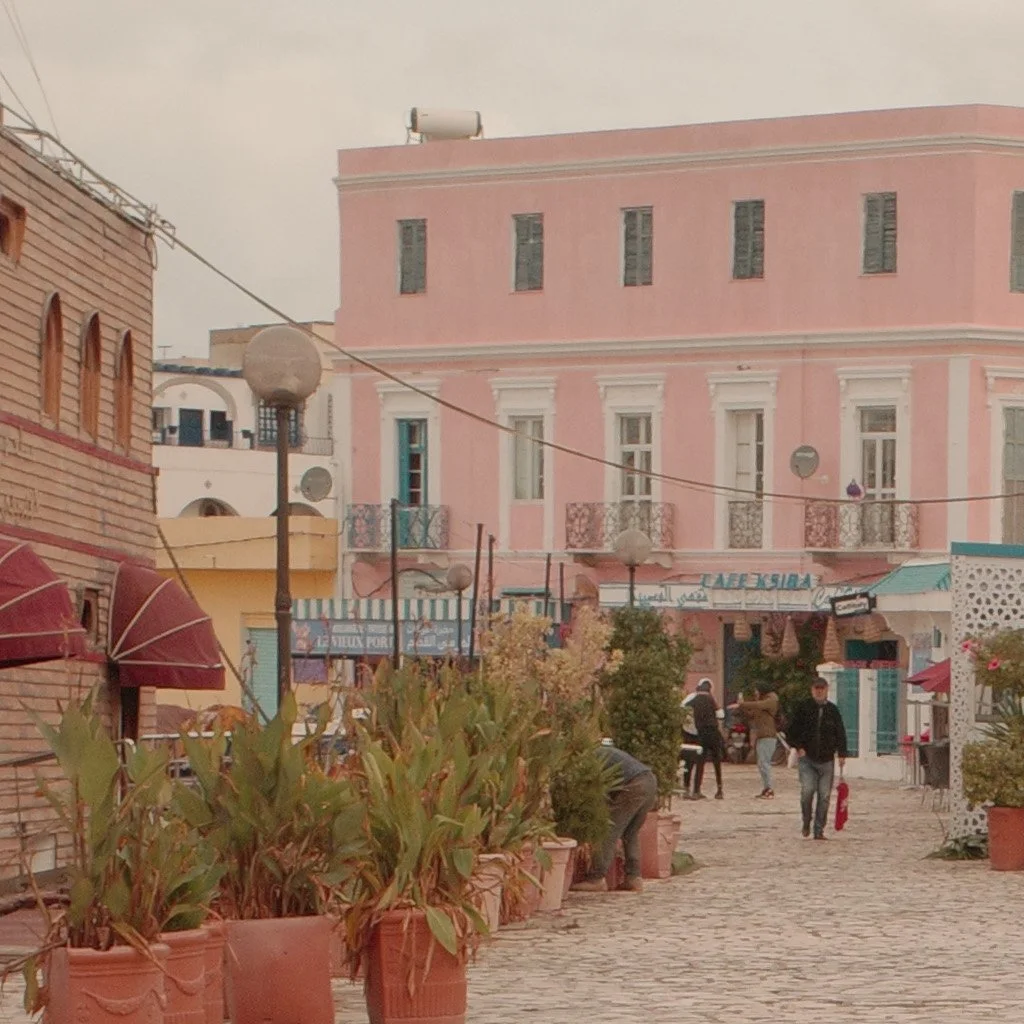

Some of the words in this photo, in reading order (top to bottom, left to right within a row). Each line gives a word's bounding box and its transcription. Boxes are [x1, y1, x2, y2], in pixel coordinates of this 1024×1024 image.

[700, 573, 748, 588] CAFE
[756, 573, 811, 588] KSIBA
[331, 635, 364, 648] VIEUX
